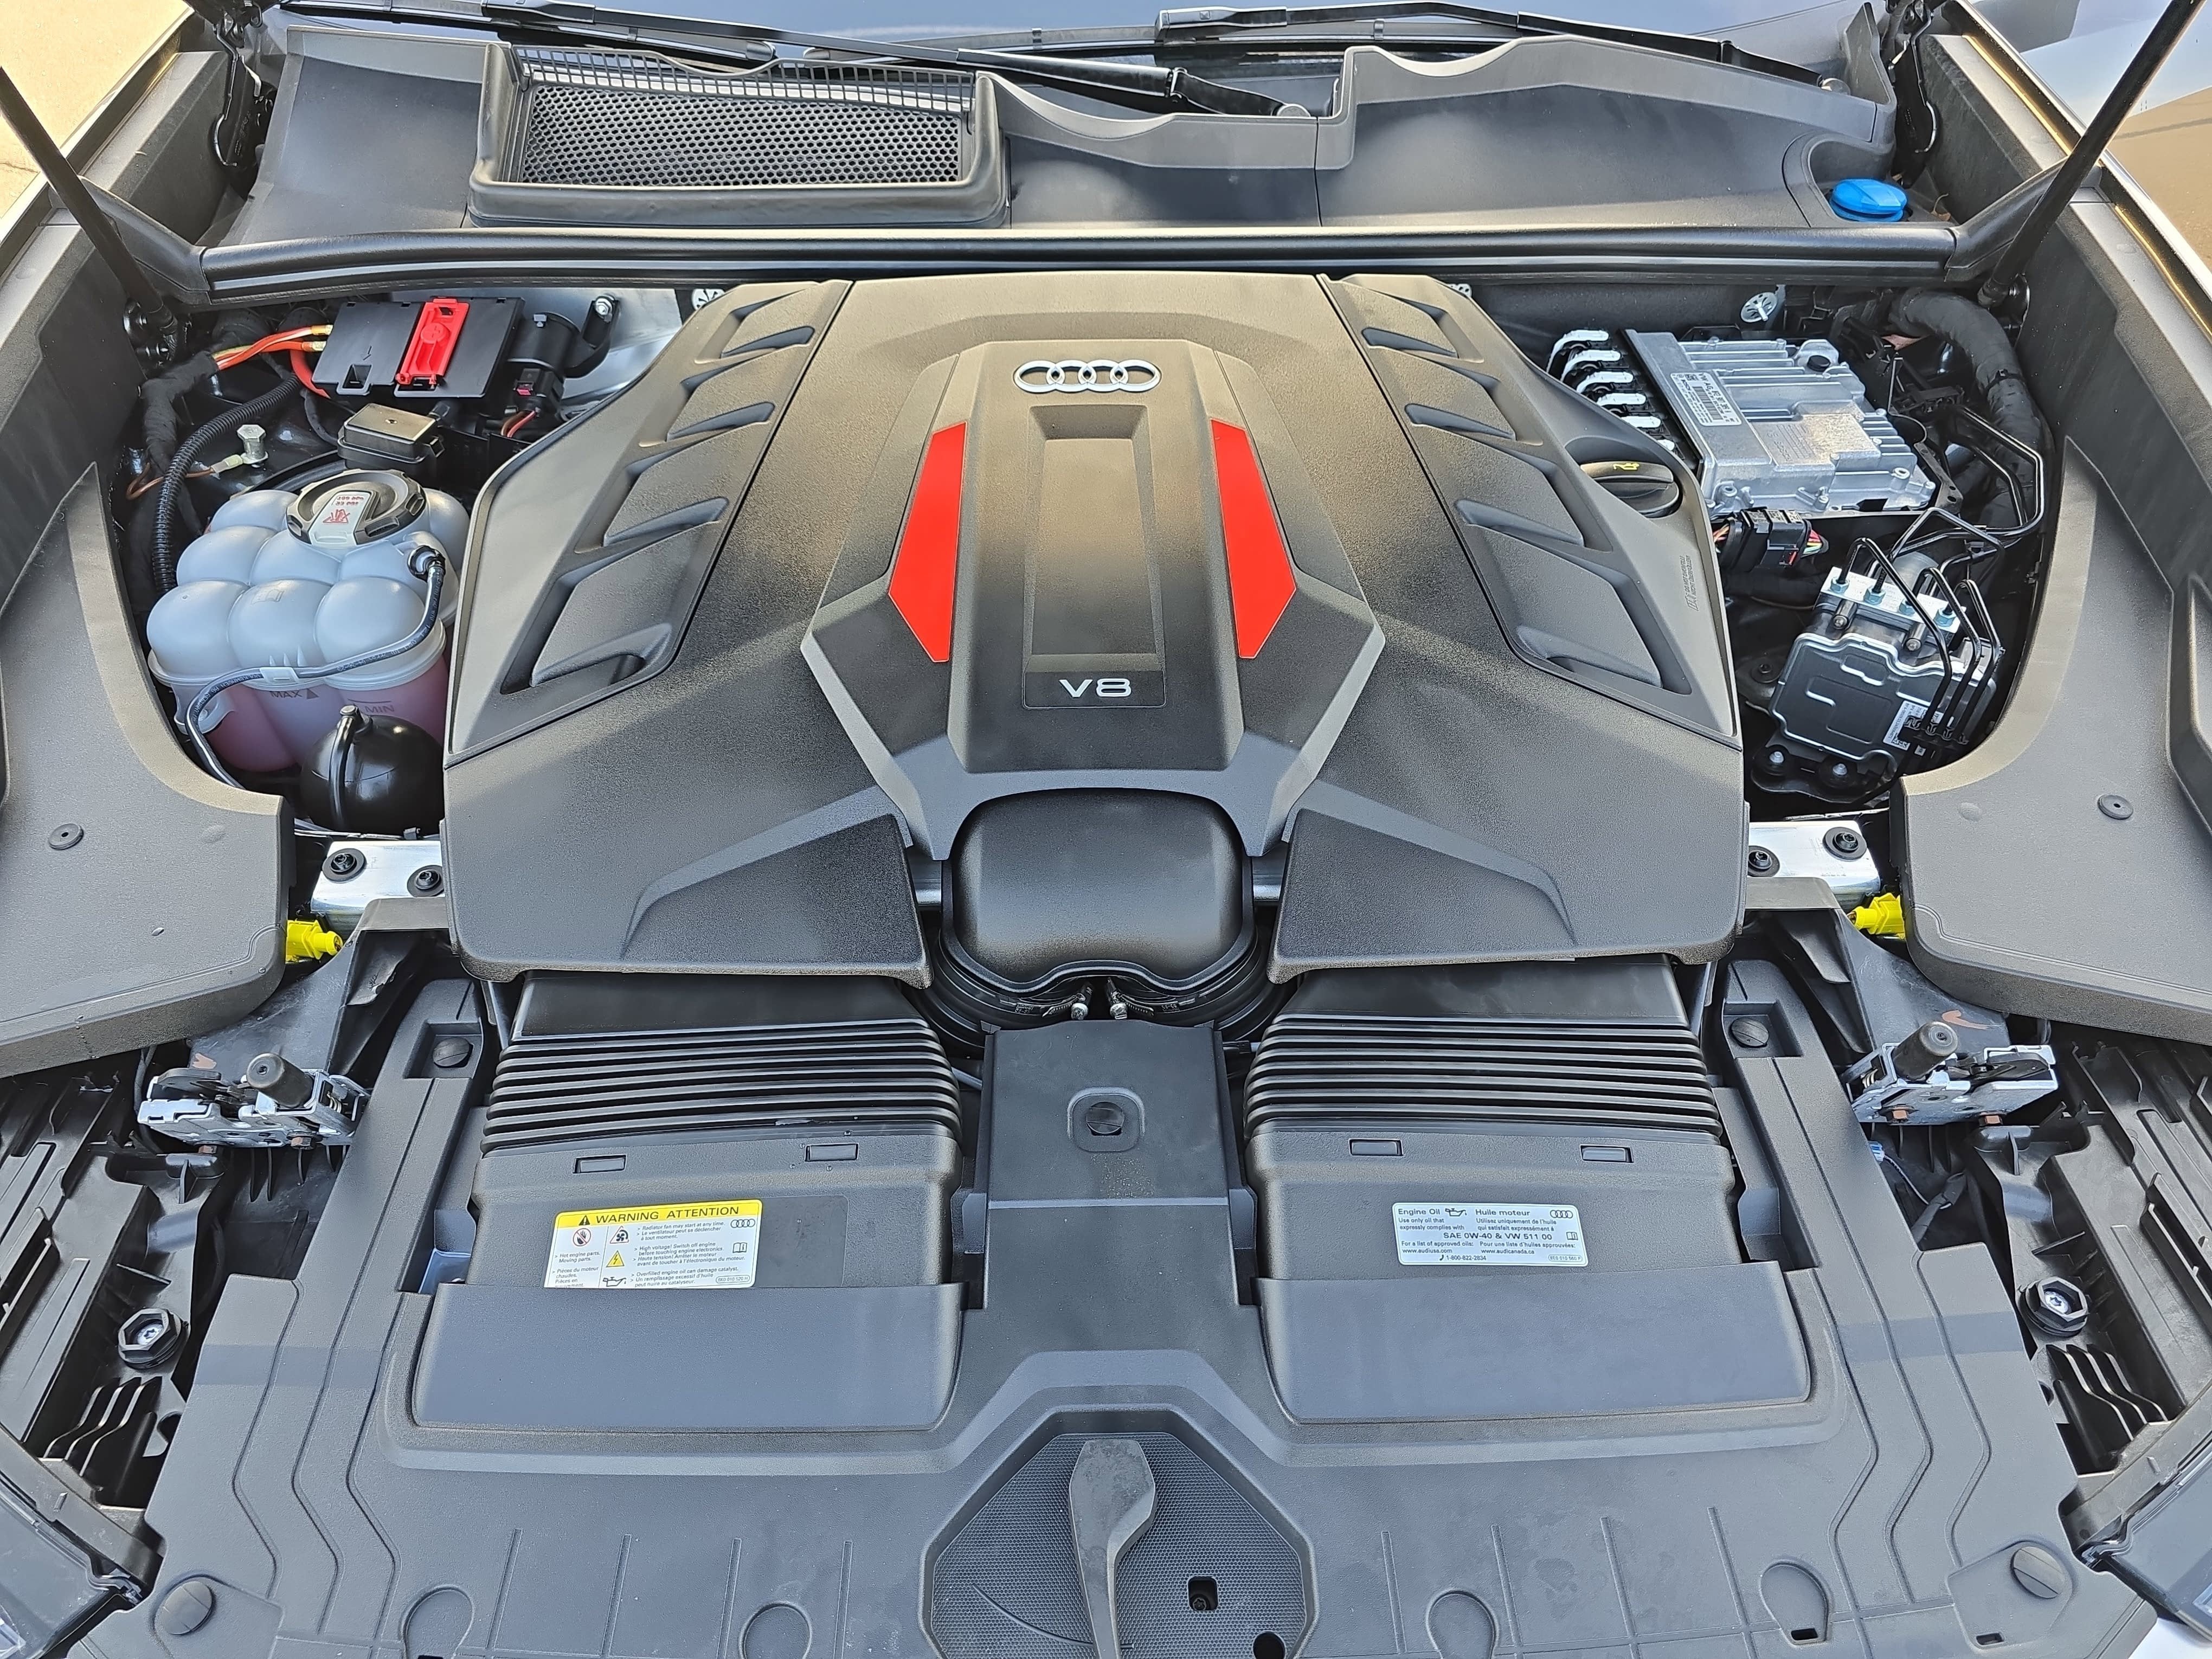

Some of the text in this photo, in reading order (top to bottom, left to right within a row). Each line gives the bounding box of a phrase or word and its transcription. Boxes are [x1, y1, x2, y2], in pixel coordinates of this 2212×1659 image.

[270, 690, 303, 698] MAX
[1059, 678, 1131, 698] V8
[364, 705, 395, 713] MIN
[596, 1206, 740, 1224] WARNING ATTENTION
